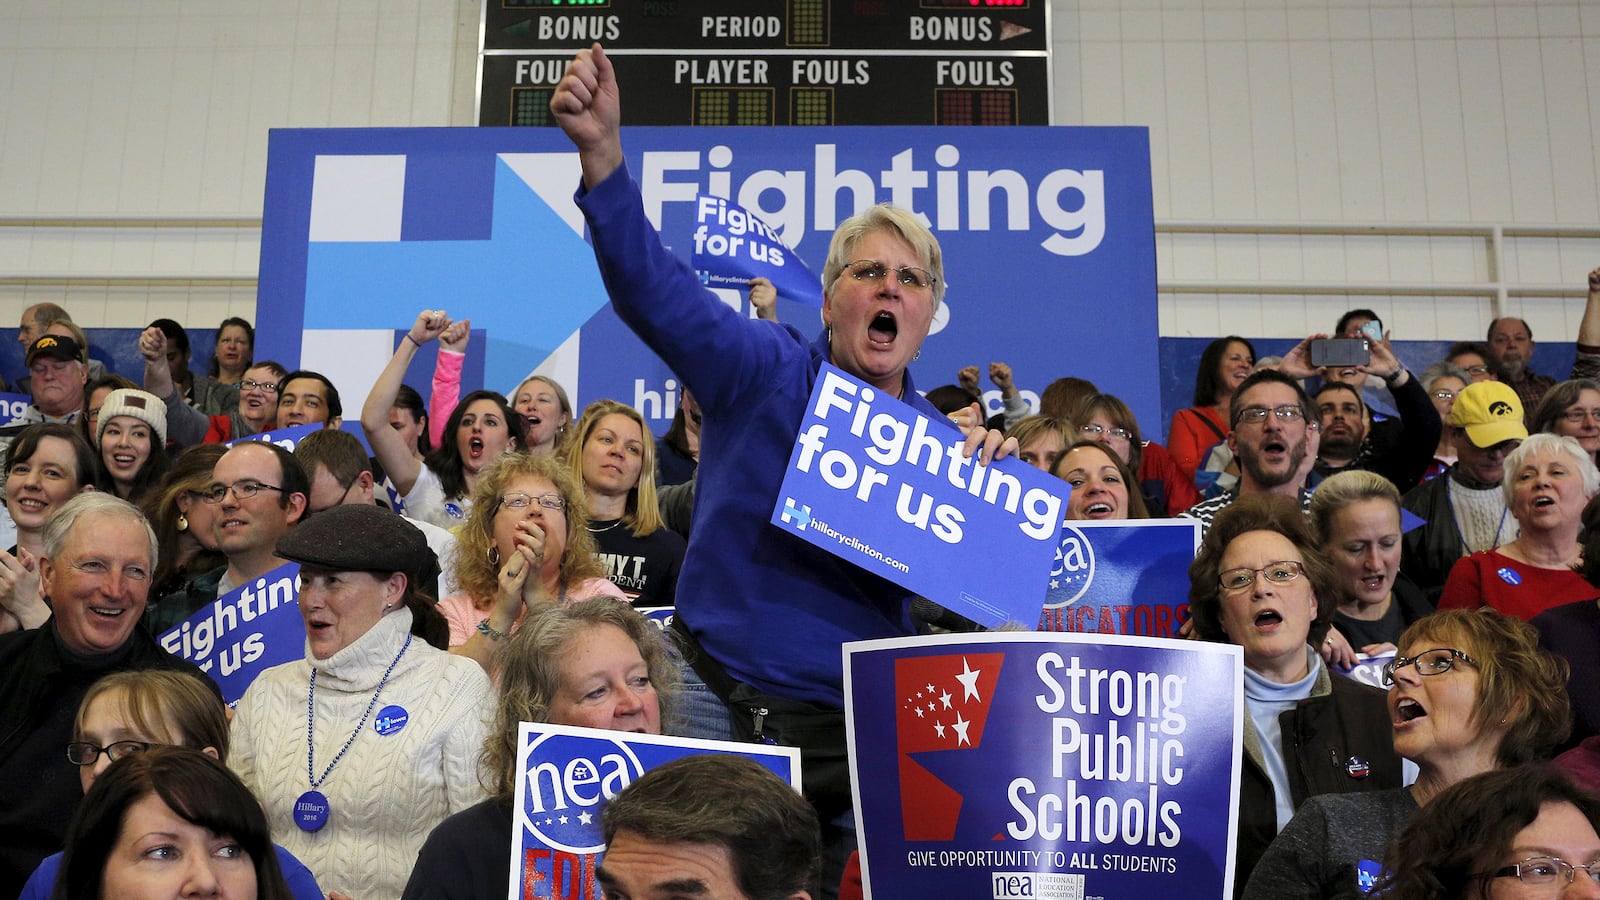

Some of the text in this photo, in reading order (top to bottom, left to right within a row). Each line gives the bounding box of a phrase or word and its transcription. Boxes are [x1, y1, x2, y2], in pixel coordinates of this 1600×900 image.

[538, 15, 620, 40] BONUS
[701, 16, 781, 38] PERIOD
[909, 16, 993, 42] BONUS
[515, 60, 571, 85] FOU
[674, 59, 769, 84] PLAYER
[792, 60, 870, 85] FOULS
[936, 61, 1015, 86] FOULS
[642, 143, 1106, 257] Fighting
[693, 225, 785, 267] for us
[813, 371, 1062, 540] Fighting
[796, 424, 967, 544] for us
[810, 516, 910, 574] hillaryclinton.com
[608, 574, 646, 590] DENT
[160, 573, 302, 661] Fightin
[1037, 603, 1190, 639] DUCATORS
[219, 632, 265, 677] us
[1035, 652, 1187, 735] Strong
[1052, 717, 1185, 786] Public
[526, 753, 632, 814] nea
[297, 802, 326, 814] Hillary
[1006, 777, 1183, 848] Schools
[908, 850, 1177, 873] GIVE OPPORTUNITY TO ALL STUDENTS
[995, 875, 1034, 897] nea
